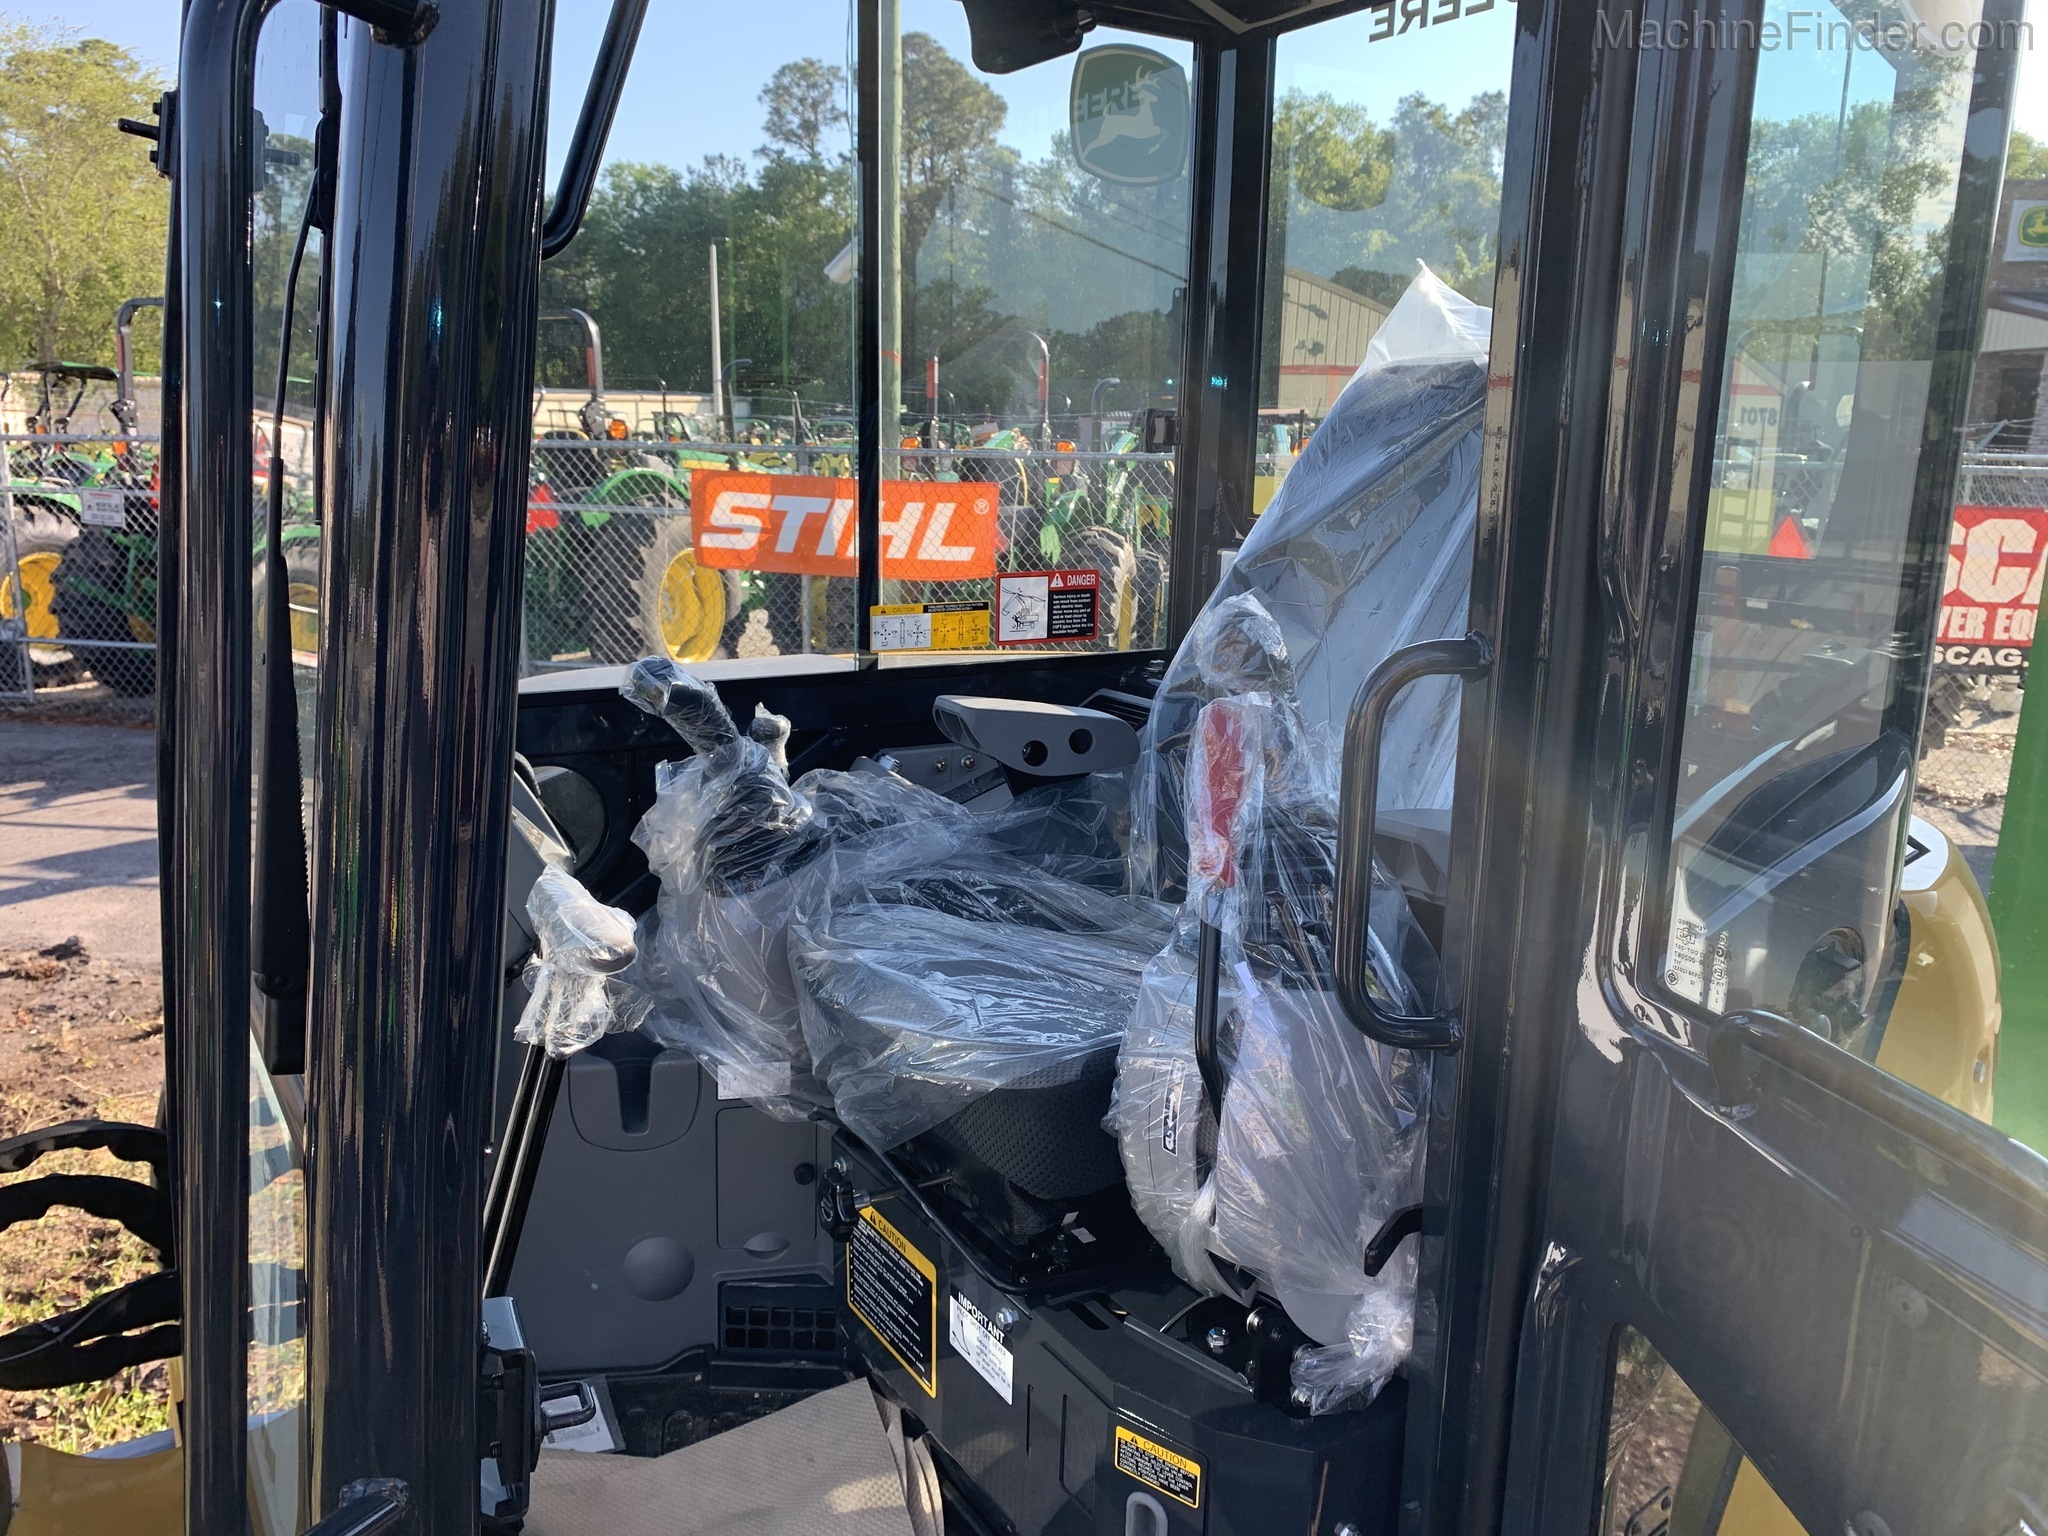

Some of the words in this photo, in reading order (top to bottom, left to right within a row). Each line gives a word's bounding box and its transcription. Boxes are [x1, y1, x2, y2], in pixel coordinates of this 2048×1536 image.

[700, 490, 976, 562] STIHL
[1067, 574, 1096, 586] DANGER
[878, 1221, 907, 1253] CAUTION
[958, 1292, 1005, 1344] IMPORTANT
[1143, 1441, 1187, 1468] CAUTION
